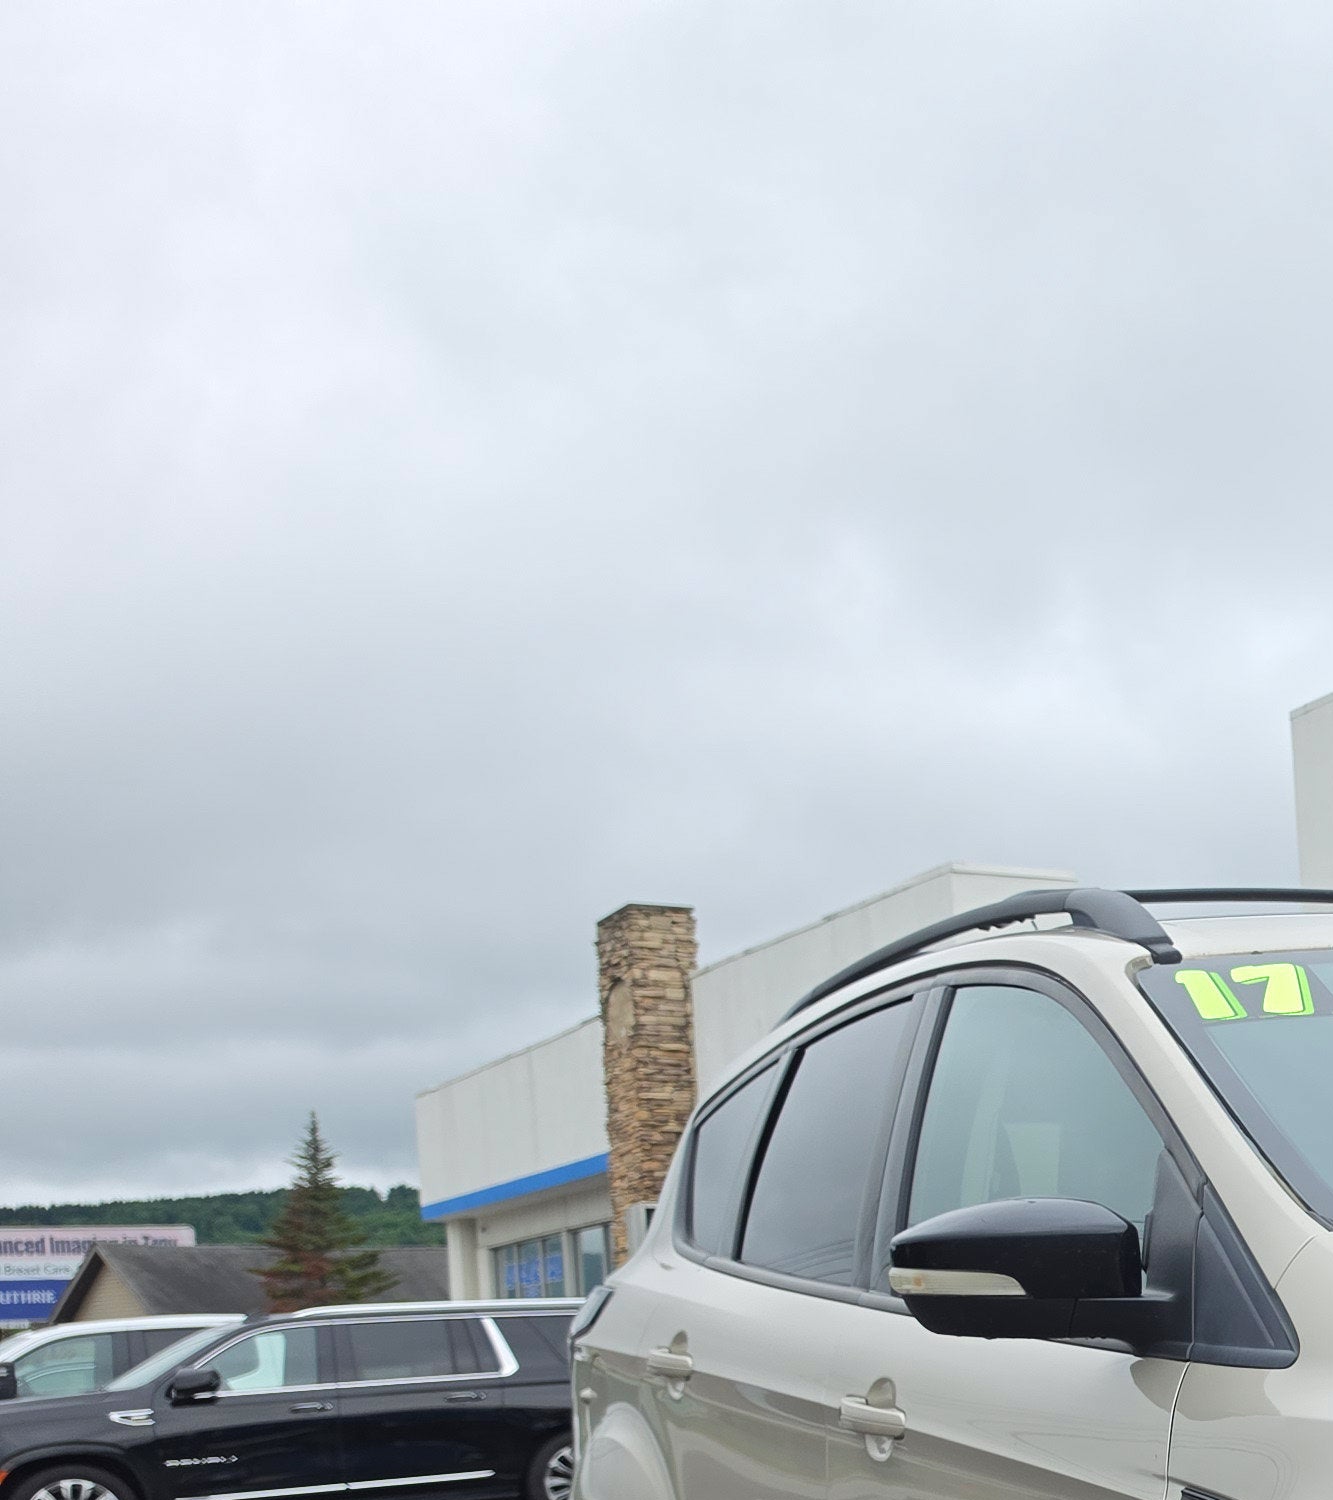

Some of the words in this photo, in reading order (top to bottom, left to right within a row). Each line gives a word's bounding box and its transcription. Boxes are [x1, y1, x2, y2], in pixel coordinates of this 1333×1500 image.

[1175, 963, 1314, 1021] 17
[0, 1237, 45, 1256] nced
[0, 1290, 57, 1305] UTHRIE
